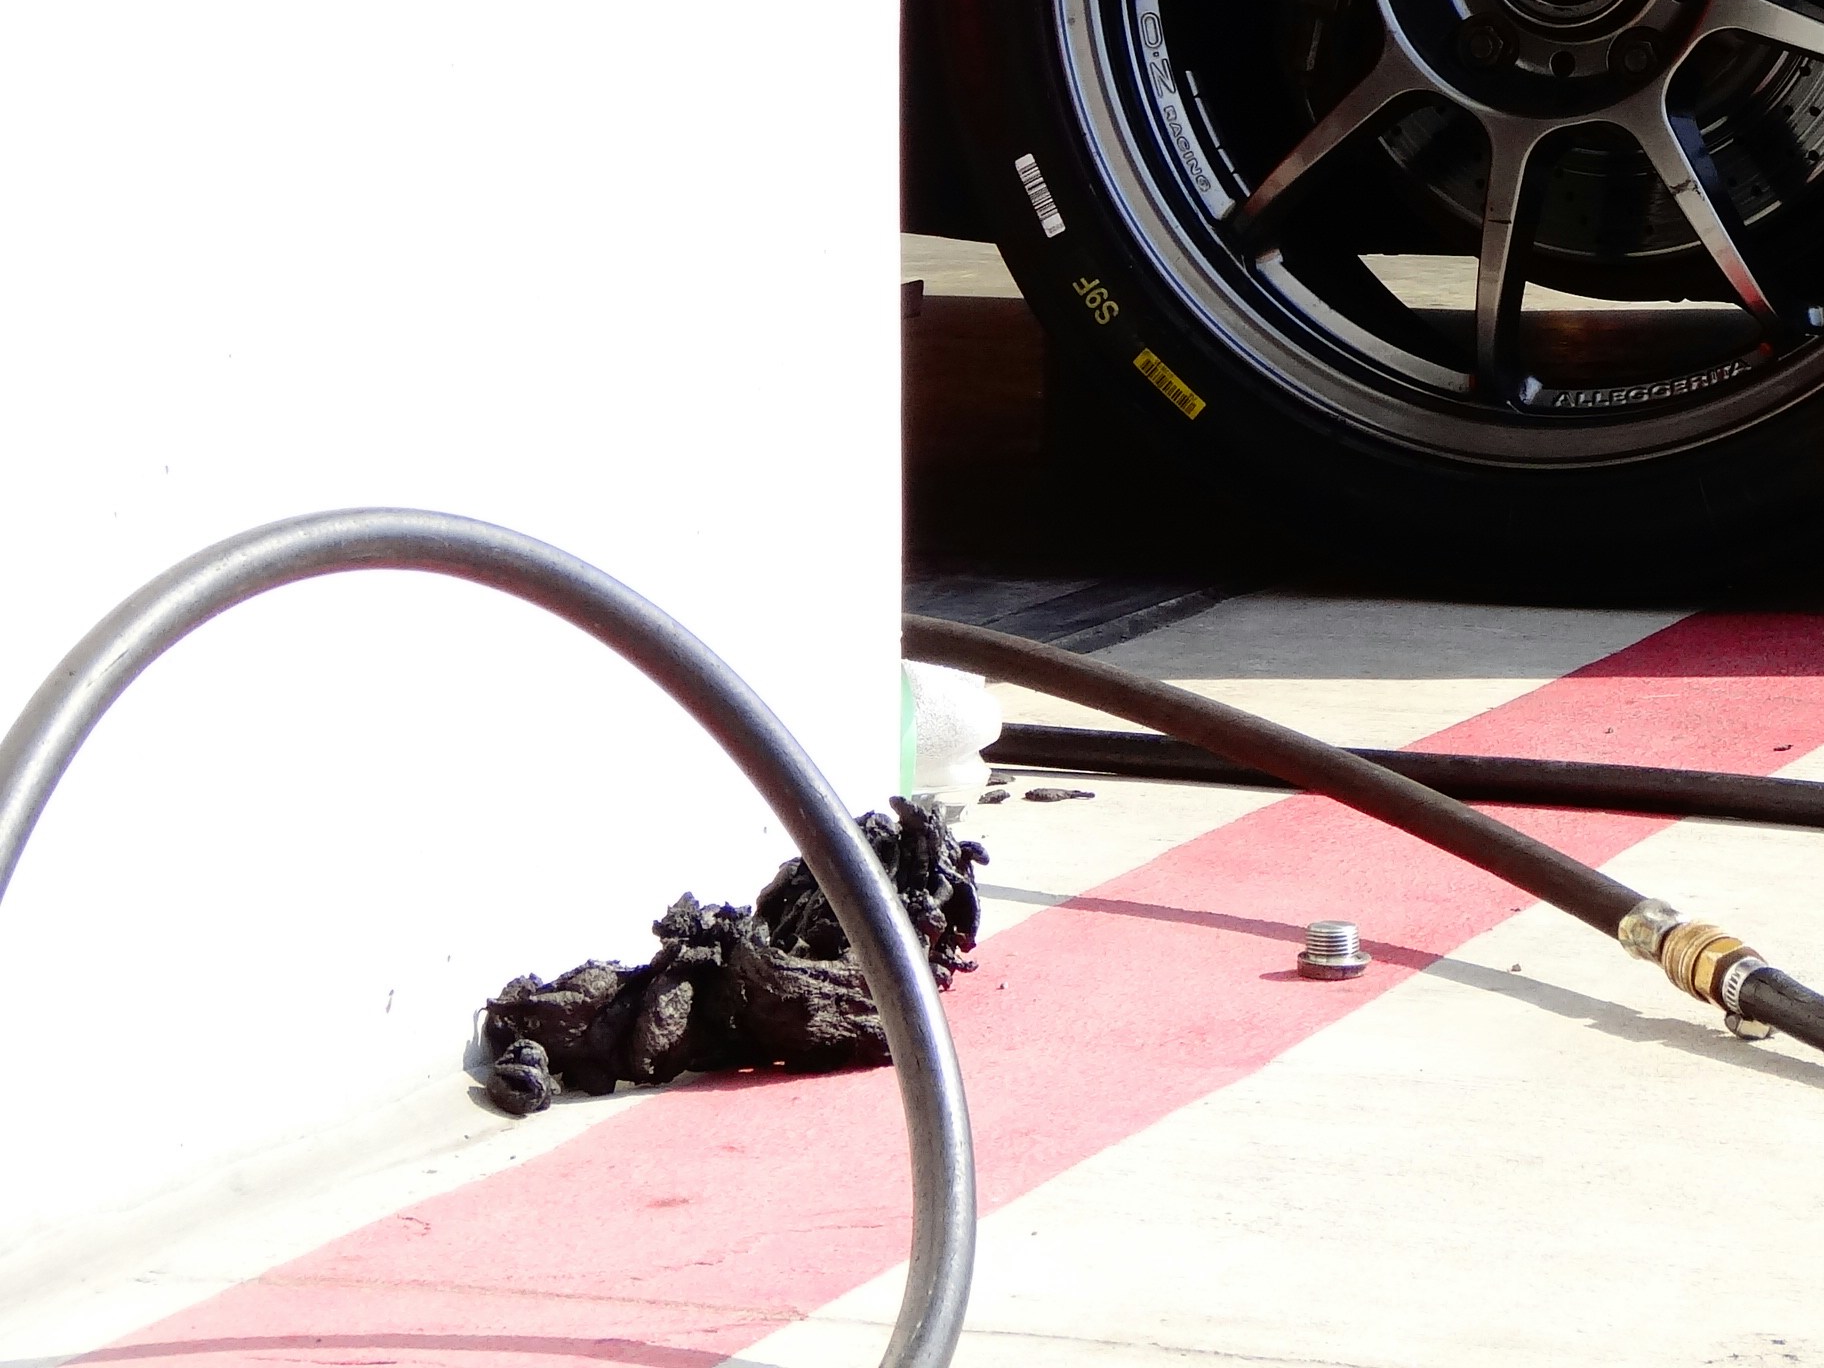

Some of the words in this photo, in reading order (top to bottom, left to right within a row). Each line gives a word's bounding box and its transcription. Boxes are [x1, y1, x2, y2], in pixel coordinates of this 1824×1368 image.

[1163, 105, 1212, 193] RACING
[1072, 276, 1119, 325] S9F
[1553, 358, 1752, 408] ALLEGGERITA
